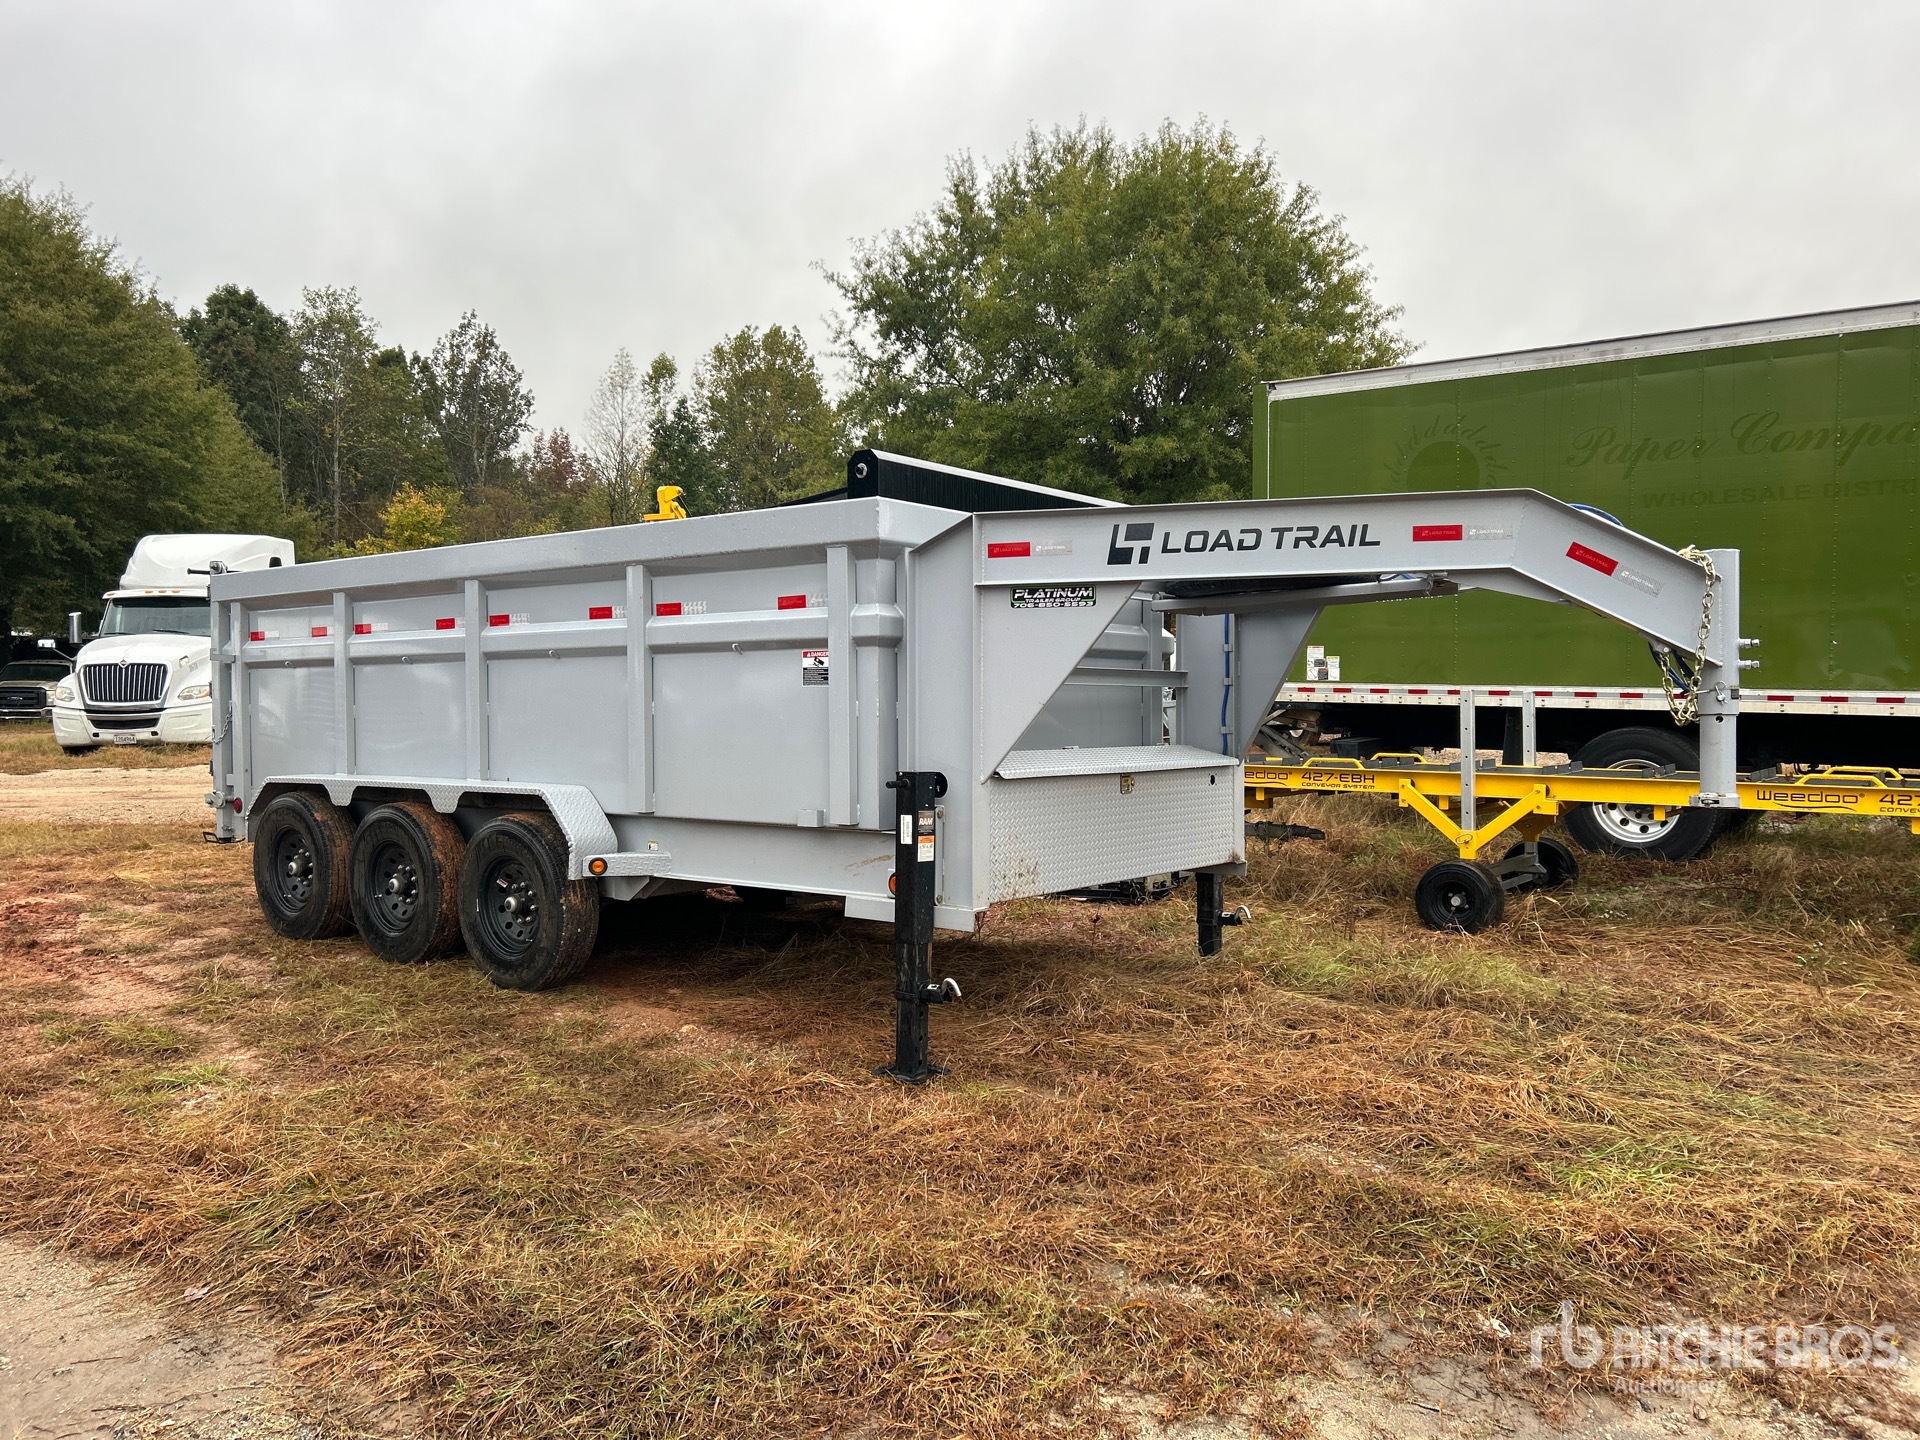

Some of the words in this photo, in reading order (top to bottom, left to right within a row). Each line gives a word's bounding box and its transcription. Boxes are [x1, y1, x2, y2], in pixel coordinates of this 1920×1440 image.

[1566, 426, 1716, 480] Paper
[1642, 484, 1810, 508] WHOLESALE
[1161, 528, 1263, 554] LOAD
[1270, 523, 1381, 550] TRAIL
[1014, 587, 1093, 599] PLATINUM
[1301, 771, 1375, 784] 427-EBH
[918, 817, 934, 826] RAM
